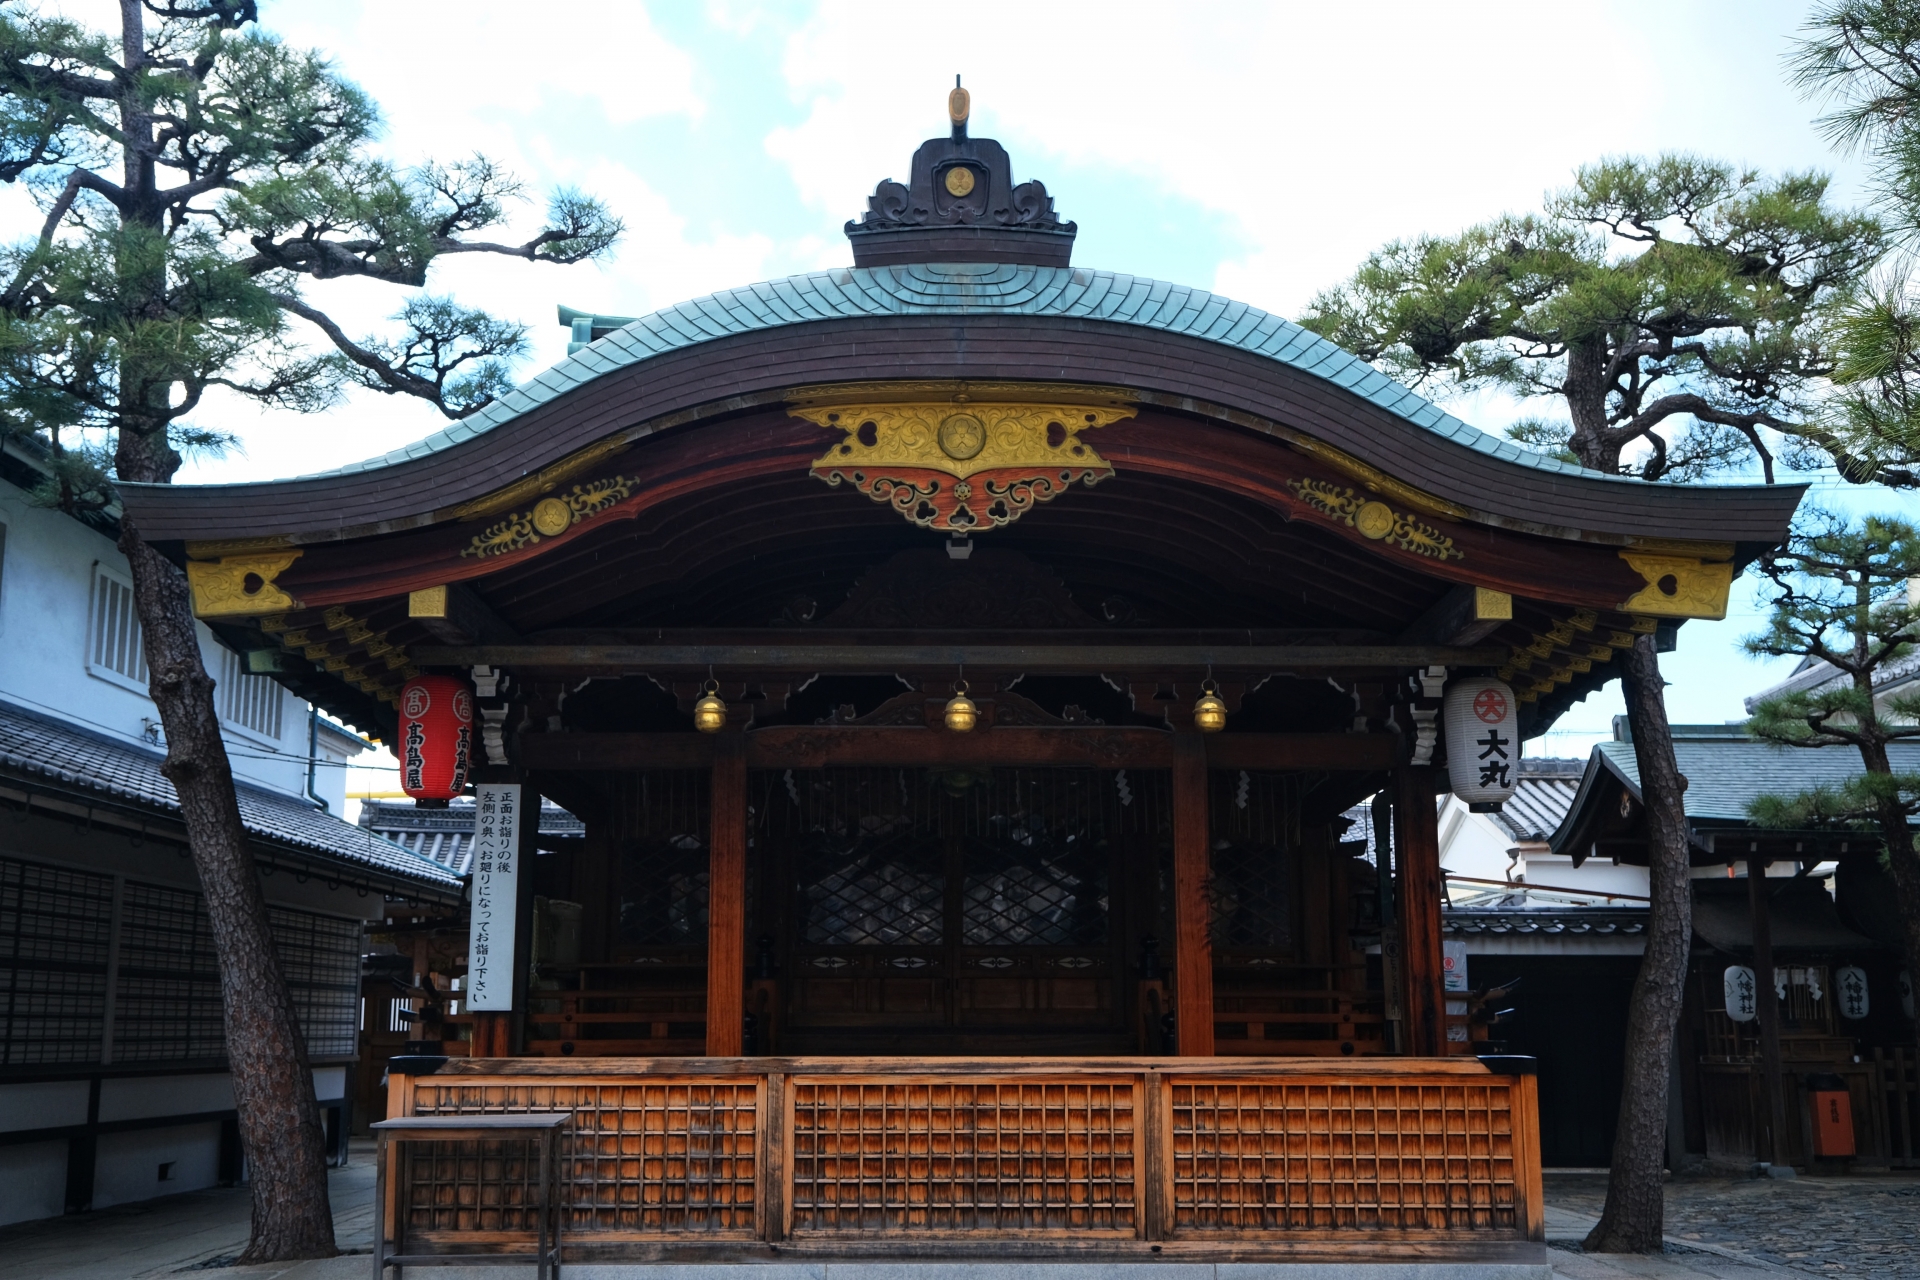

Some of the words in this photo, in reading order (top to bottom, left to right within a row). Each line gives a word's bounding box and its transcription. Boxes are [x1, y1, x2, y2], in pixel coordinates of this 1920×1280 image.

[1476, 729, 1511, 788] 大丸
[497, 791, 514, 873] 正面お詣りの後
[473, 791, 496, 1003] 左側の奥へお廻りになってお詣り下さい
[1736, 969, 1754, 1015] 八幡神社
[1844, 970, 1864, 1015] 八幡神社
